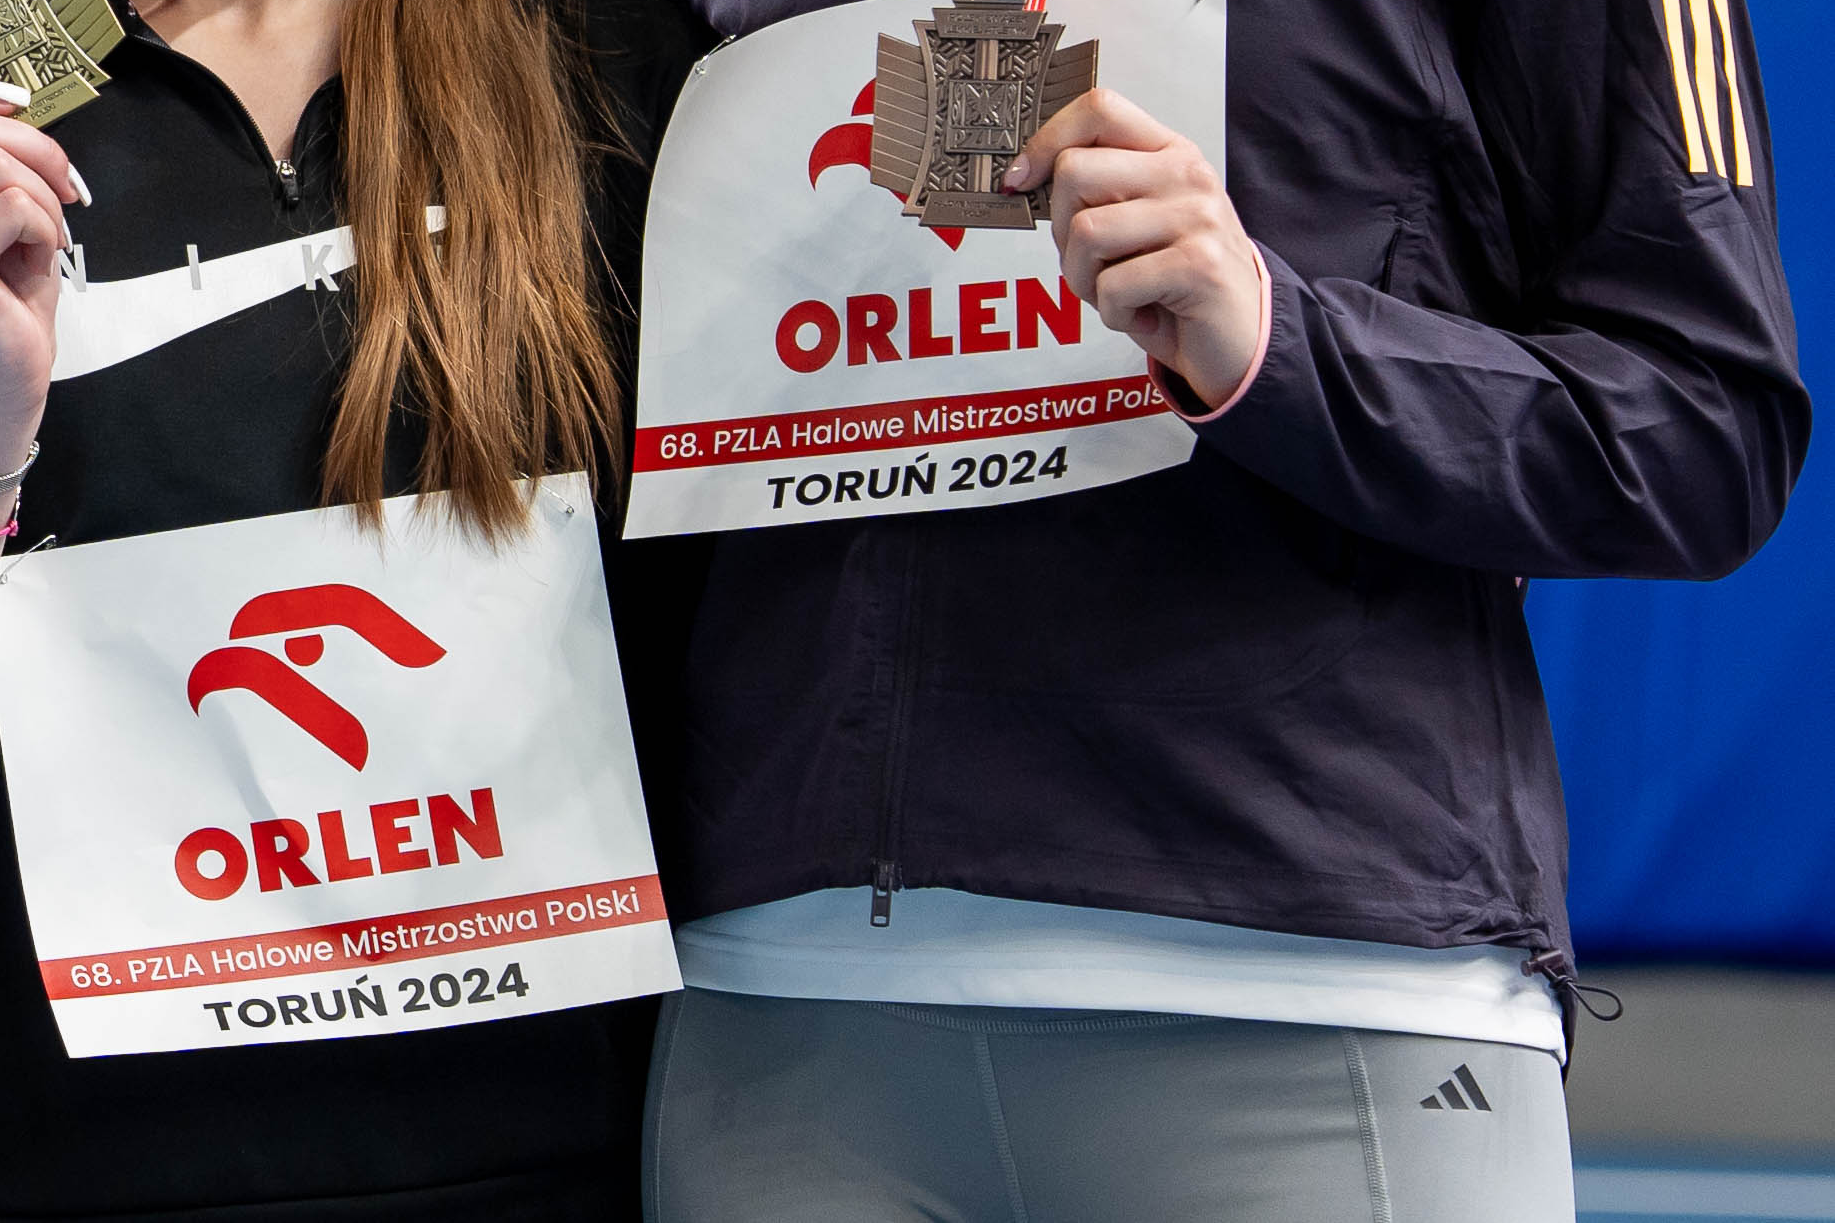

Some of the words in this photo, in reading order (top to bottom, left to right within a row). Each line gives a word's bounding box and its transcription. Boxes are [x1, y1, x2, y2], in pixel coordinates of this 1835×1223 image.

[954, 128, 1014, 150] PZLA
[58, 244, 340, 293] NIK
[775, 275, 1082, 374] ORLEN
[659, 432, 704, 460] 68.
[713, 424, 783, 455] PZLA
[791, 411, 905, 448] Halowe
[913, 393, 1097, 437] Mistrzostwa
[1106, 381, 1166, 412] Pols
[767, 450, 936, 510] TORUŃ
[949, 445, 1069, 492] 2024
[174, 786, 504, 901] ORLEN
[70, 962, 122, 990] 68.
[128, 953, 204, 984] PZLA
[212, 935, 335, 974] Halowe
[342, 903, 539, 959] Mistrzostwa
[546, 886, 641, 926] Polski
[204, 974, 386, 1032] TORUŃ
[398, 961, 530, 1012] 2024
